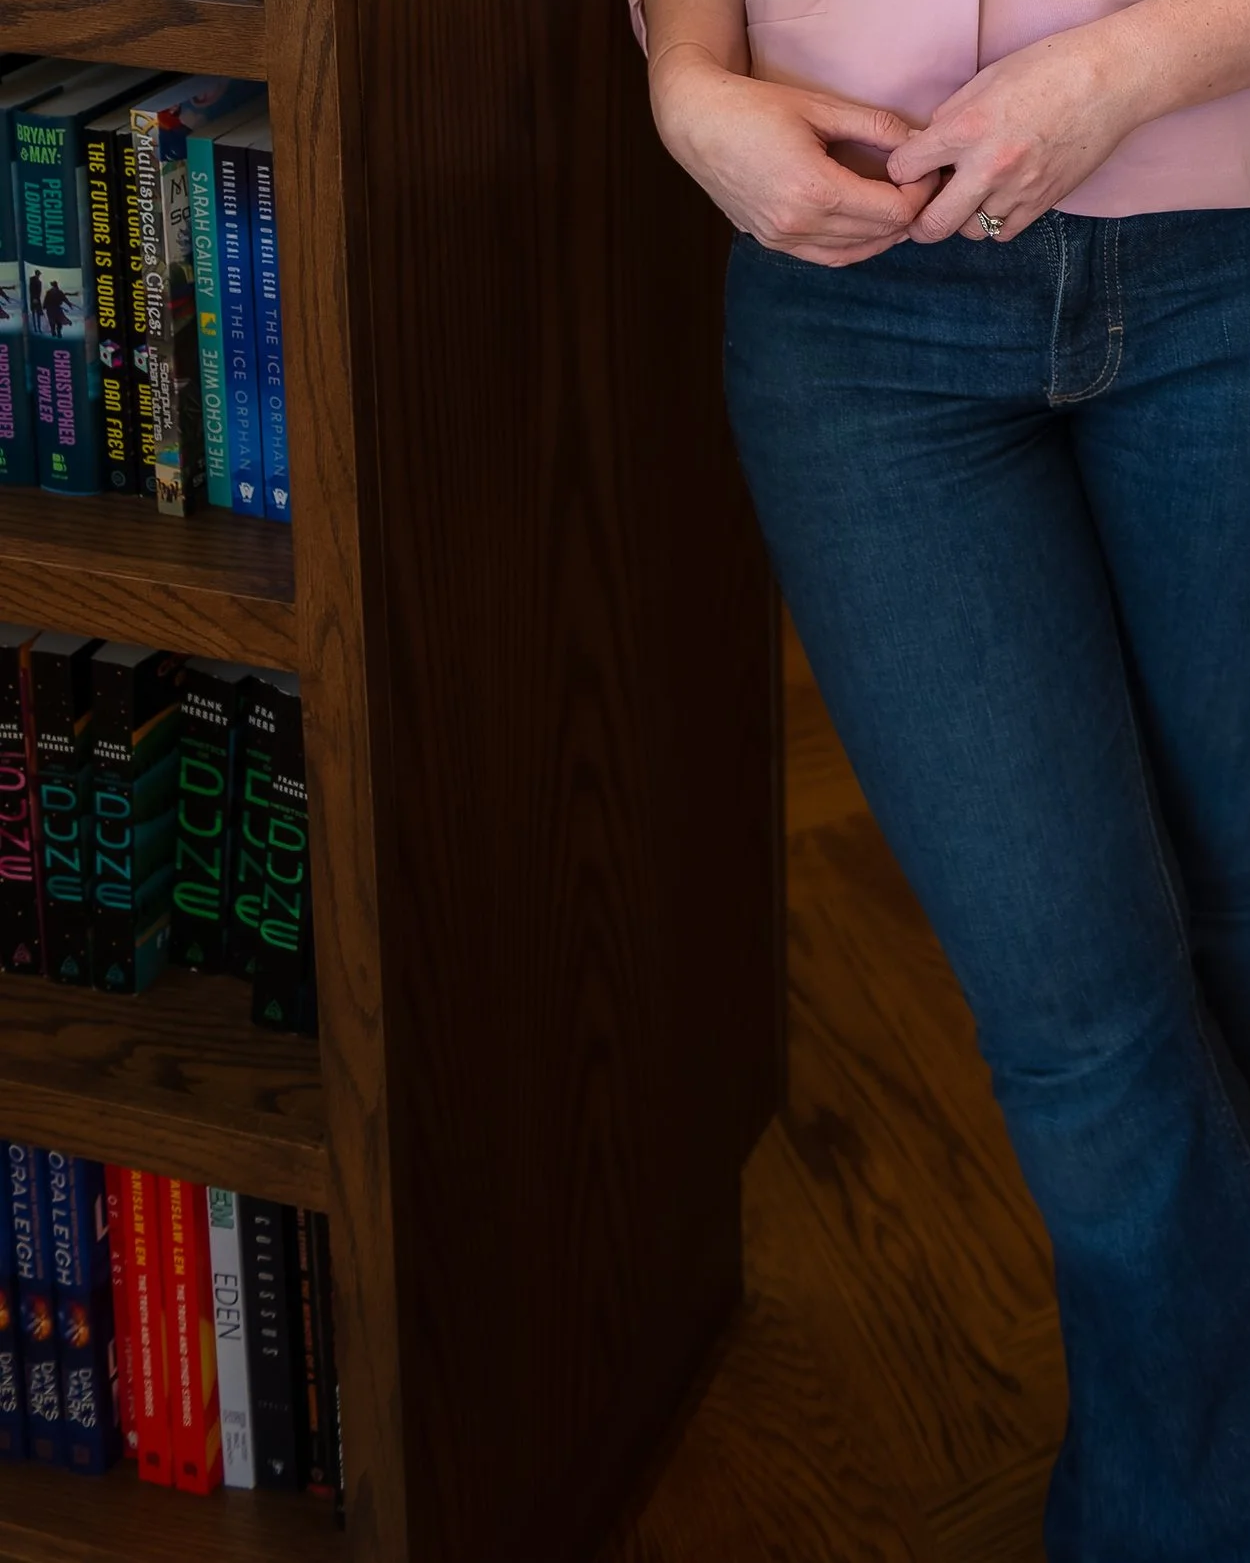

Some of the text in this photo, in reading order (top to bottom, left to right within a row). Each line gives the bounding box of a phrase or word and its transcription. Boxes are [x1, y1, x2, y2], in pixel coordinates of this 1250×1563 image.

[16, 123, 66, 146] BRYANT
[87, 142, 106, 174] THE
[24, 182, 44, 246] LONDON
[42, 178, 65, 255] PECULIAR
[89, 180, 111, 245] FUTURE
[136, 134, 164, 336] Multispecies Cities:
[192, 171, 214, 298] SARAH GAILEY
[221, 160, 242, 294] KATHLEEN O'NEAL GEAR
[256, 165, 277, 300] KATHLEEN O'NEAL GEAR
[94, 250, 113, 268] IS
[36, 366, 54, 424] FOWLER
[53, 350, 76, 446] CHRISTOPHER
[148, 346, 162, 441] Urban Futures
[160, 362, 173, 430] Solarpunk
[202, 349, 225, 479] THE ECHO WIFE
[230, 304, 252, 471] THE ICE ORPHAN
[265, 309, 286, 478] THE ICE ORPHAN
[0, 723, 18, 731] ANK
[181, 703, 229, 726] HERBERT
[186, 692, 223, 713] FRANK
[248, 714, 276, 734] HERB
[254, 704, 275, 721] FRA
[37, 741, 76, 754] HERBERT
[41, 733, 70, 744] FRANK
[94, 748, 132, 762] HERBERT
[97, 740, 128, 752] FRANK
[278, 774, 305, 790] FRANK
[0, 765, 33, 882] DUNE
[40, 784, 84, 902] DUNE
[95, 791, 132, 910] DUNE
[172, 756, 226, 922] DUNE
[260, 817, 306, 952] DUNE
[8, 1144, 34, 1279] ORA LEIGH
[48, 1150, 72, 1286] ORA LEIGH
[130, 1169, 145, 1236] ANISLAW
[170, 1178, 184, 1245] ANISLAW
[209, 1188, 235, 1230] EM
[214, 1272, 242, 1341] EDEN
[254, 1215, 280, 1358] COLOSSUS
[41, 1360, 60, 1422] DANE'S
[78, 1368, 98, 1428] DANE'S
